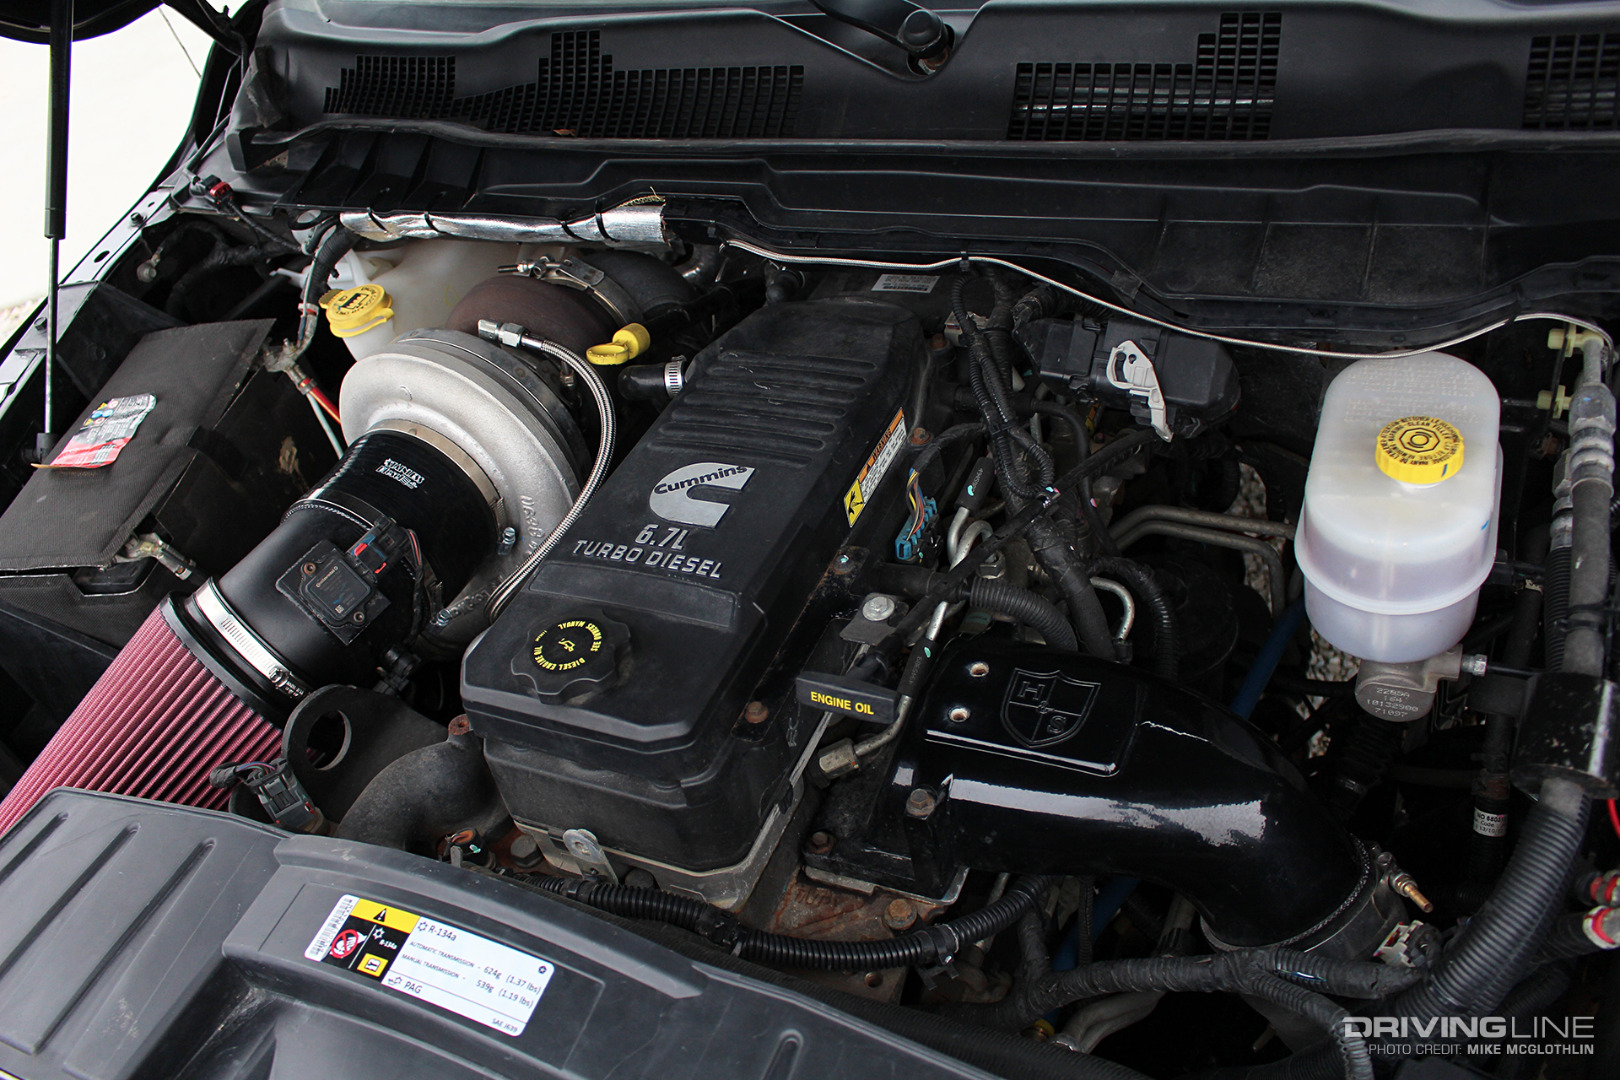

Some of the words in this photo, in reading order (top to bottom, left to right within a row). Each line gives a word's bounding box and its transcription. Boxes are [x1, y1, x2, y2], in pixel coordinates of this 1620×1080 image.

[653, 465, 747, 495] Cummins
[635, 524, 689, 551] 6.7L
[572, 539, 644, 563] TURBO
[645, 551, 723, 579] DIESEL
[557, 620, 586, 629] MANUAL
[558, 657, 586, 670] DIESEL
[810, 691, 852, 711] ENGINE
[854, 702, 875, 715] OIL
[1017, 680, 1046, 700] H
[1046, 715, 1066, 734] S
[426, 924, 457, 942] R-134a
[401, 953, 422, 966] MANUAL
[422, 960, 460, 979] TRANSMISSION
[475, 979, 495, 994] 539g
[498, 988, 519, 1002] (1.19
[518, 995, 534, 1009] lbs)
[409, 941, 438, 955] AUTOMATIC
[437, 950, 475, 968] TRANSMISSION
[483, 965, 502, 980] 624g
[505, 974, 527, 988] (1.37
[526, 982, 542, 996] lbs)
[403, 980, 423, 994] PAG
